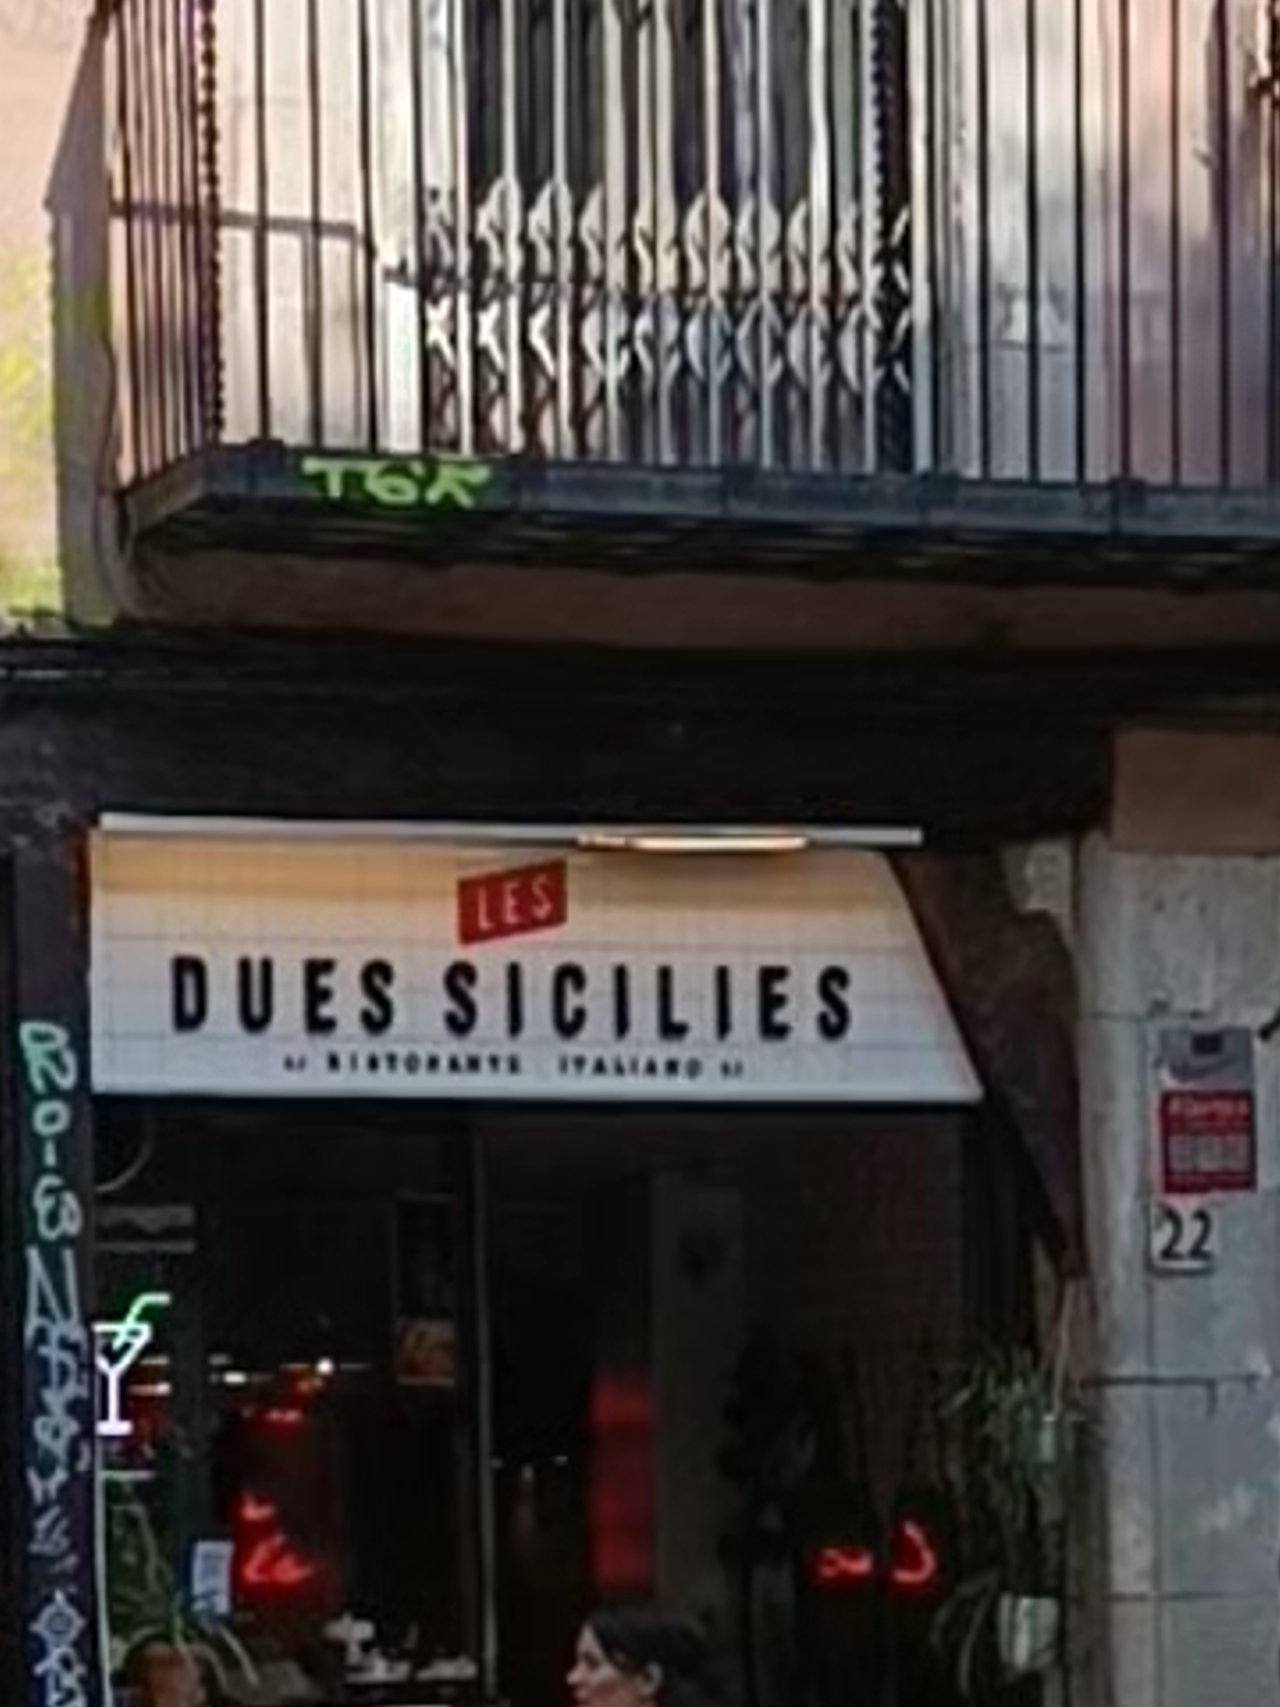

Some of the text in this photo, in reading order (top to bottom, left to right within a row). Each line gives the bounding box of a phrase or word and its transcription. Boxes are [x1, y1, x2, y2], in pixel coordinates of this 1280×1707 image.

[477, 873, 553, 931] LES
[171, 954, 852, 1041] DUES SICILIES
[1158, 1205, 1213, 1261] 22
